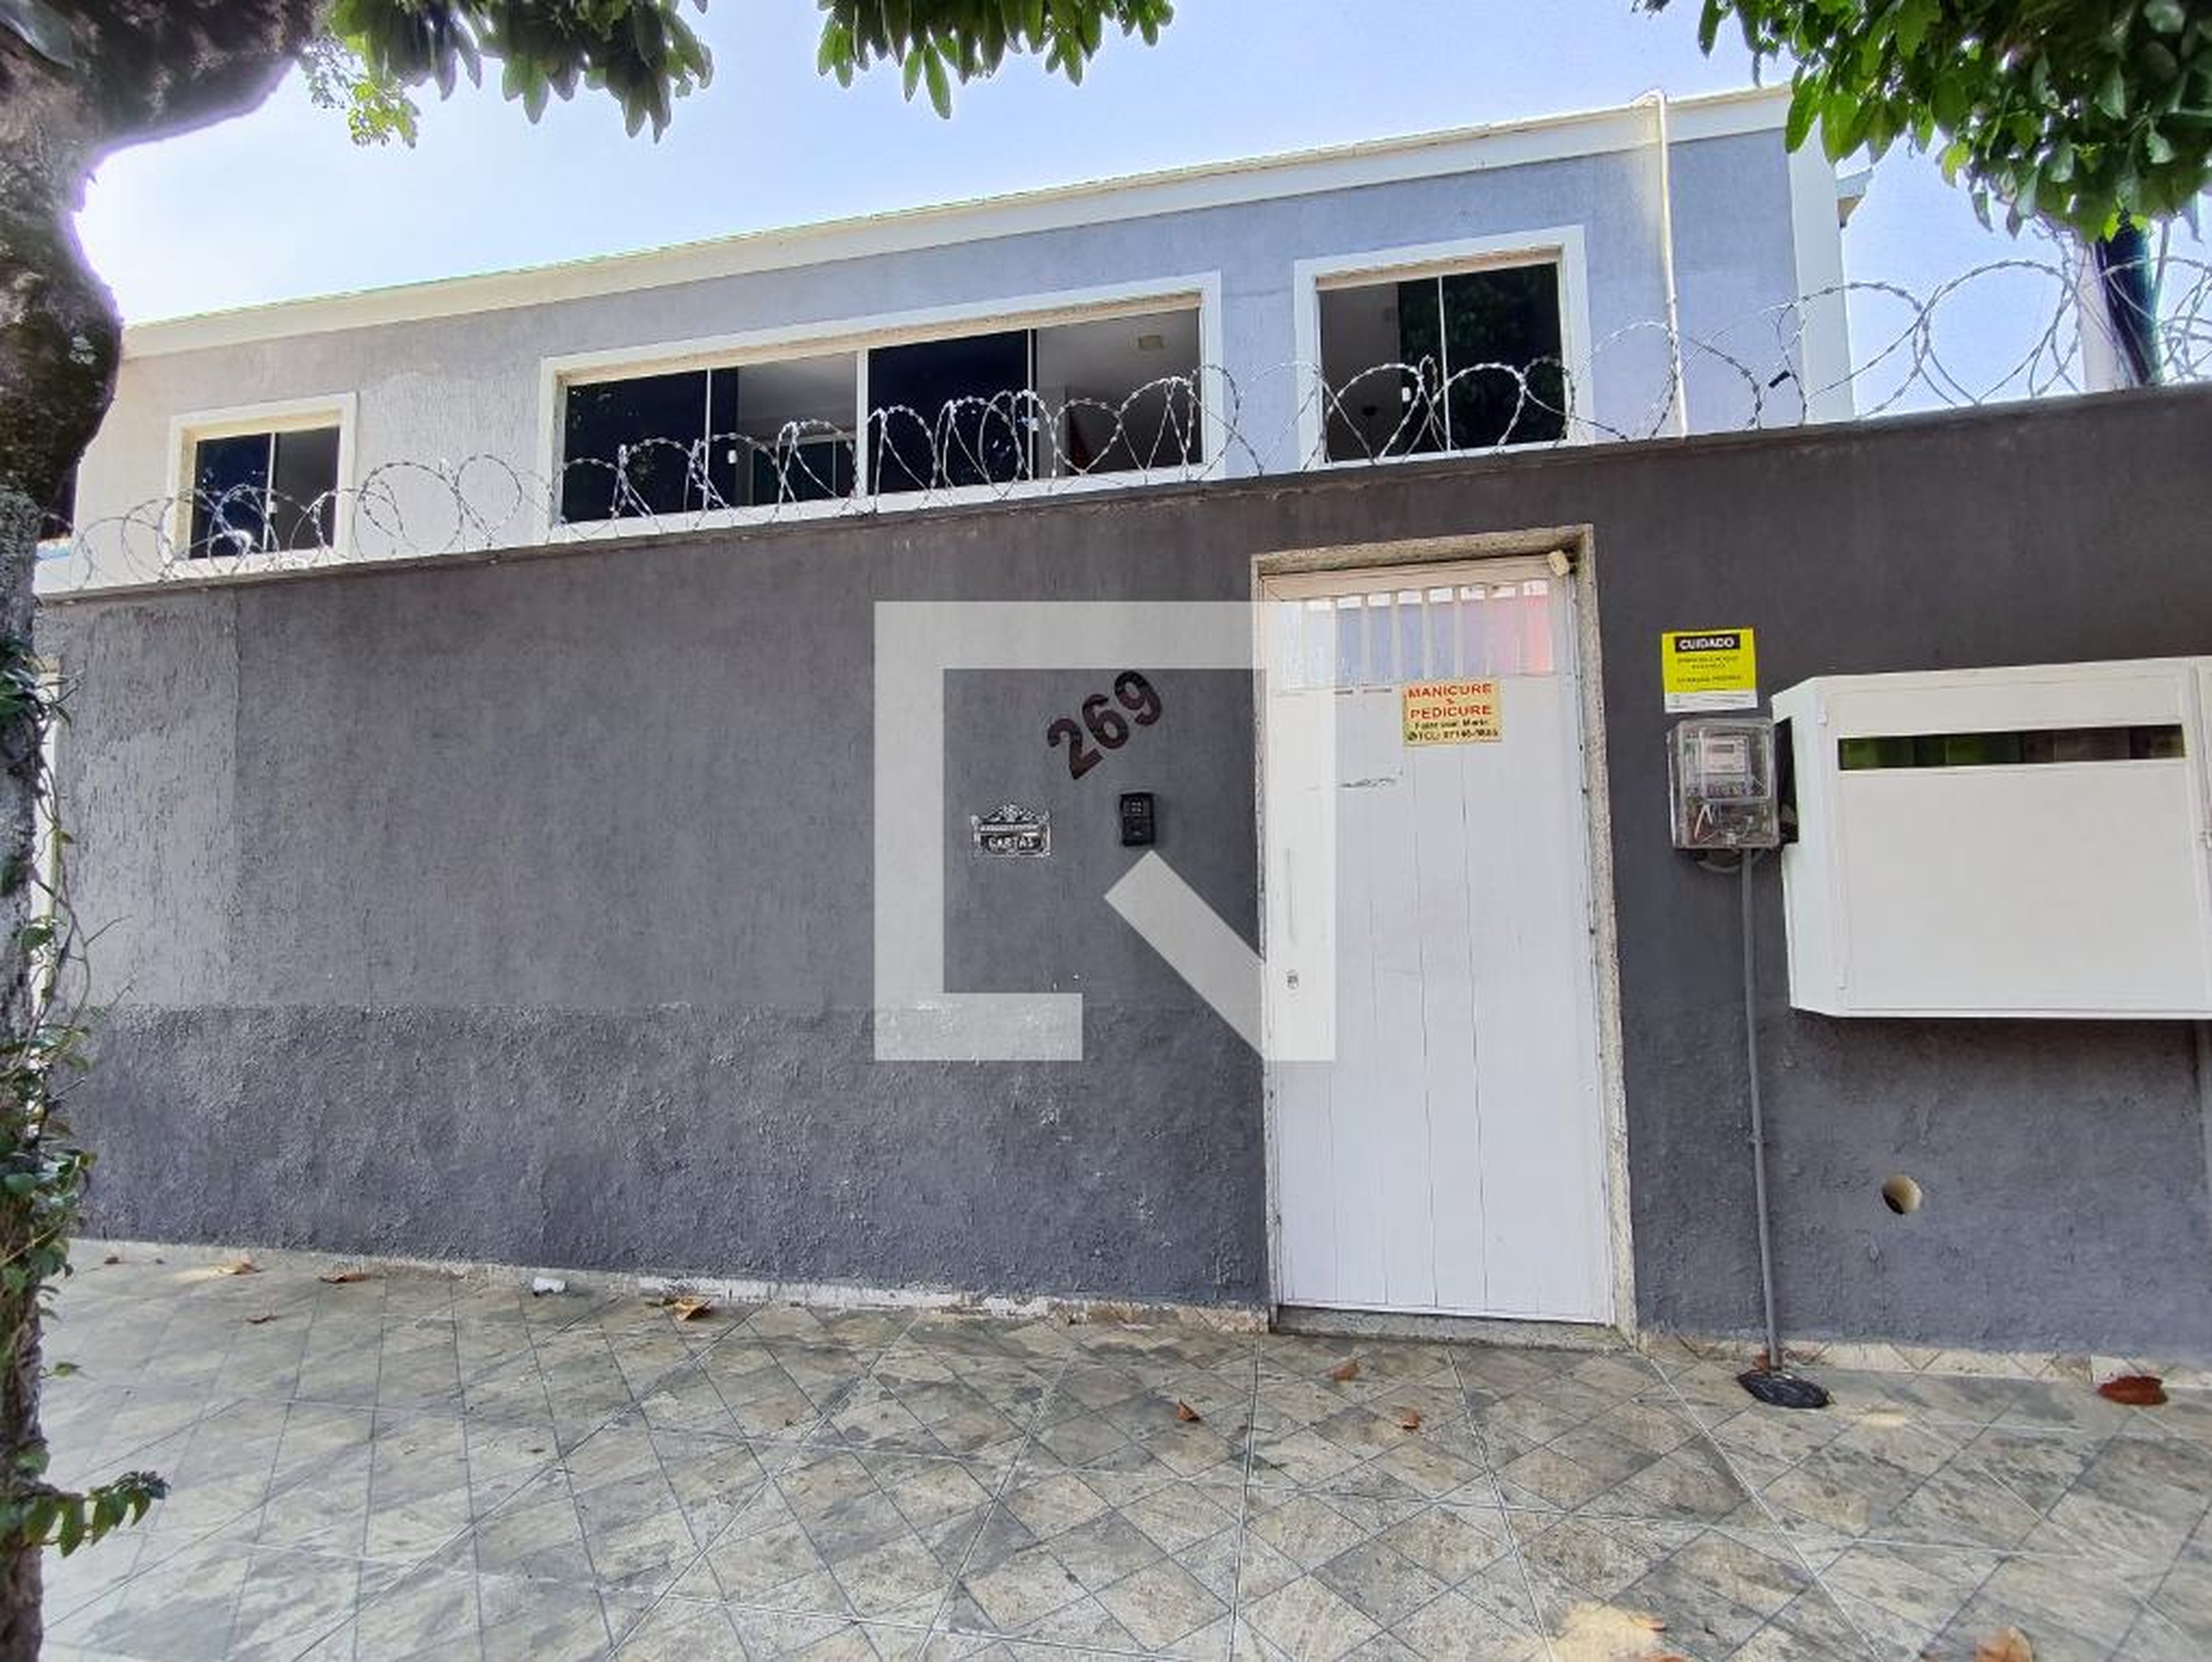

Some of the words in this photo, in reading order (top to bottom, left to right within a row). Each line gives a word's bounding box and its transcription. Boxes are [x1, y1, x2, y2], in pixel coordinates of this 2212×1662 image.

[1679, 637, 1735, 650] CUIDADO
[1408, 683, 1491, 699] MANICURE
[1410, 705, 1491, 719] PEDICURE
[1047, 670, 1161, 780] 269
